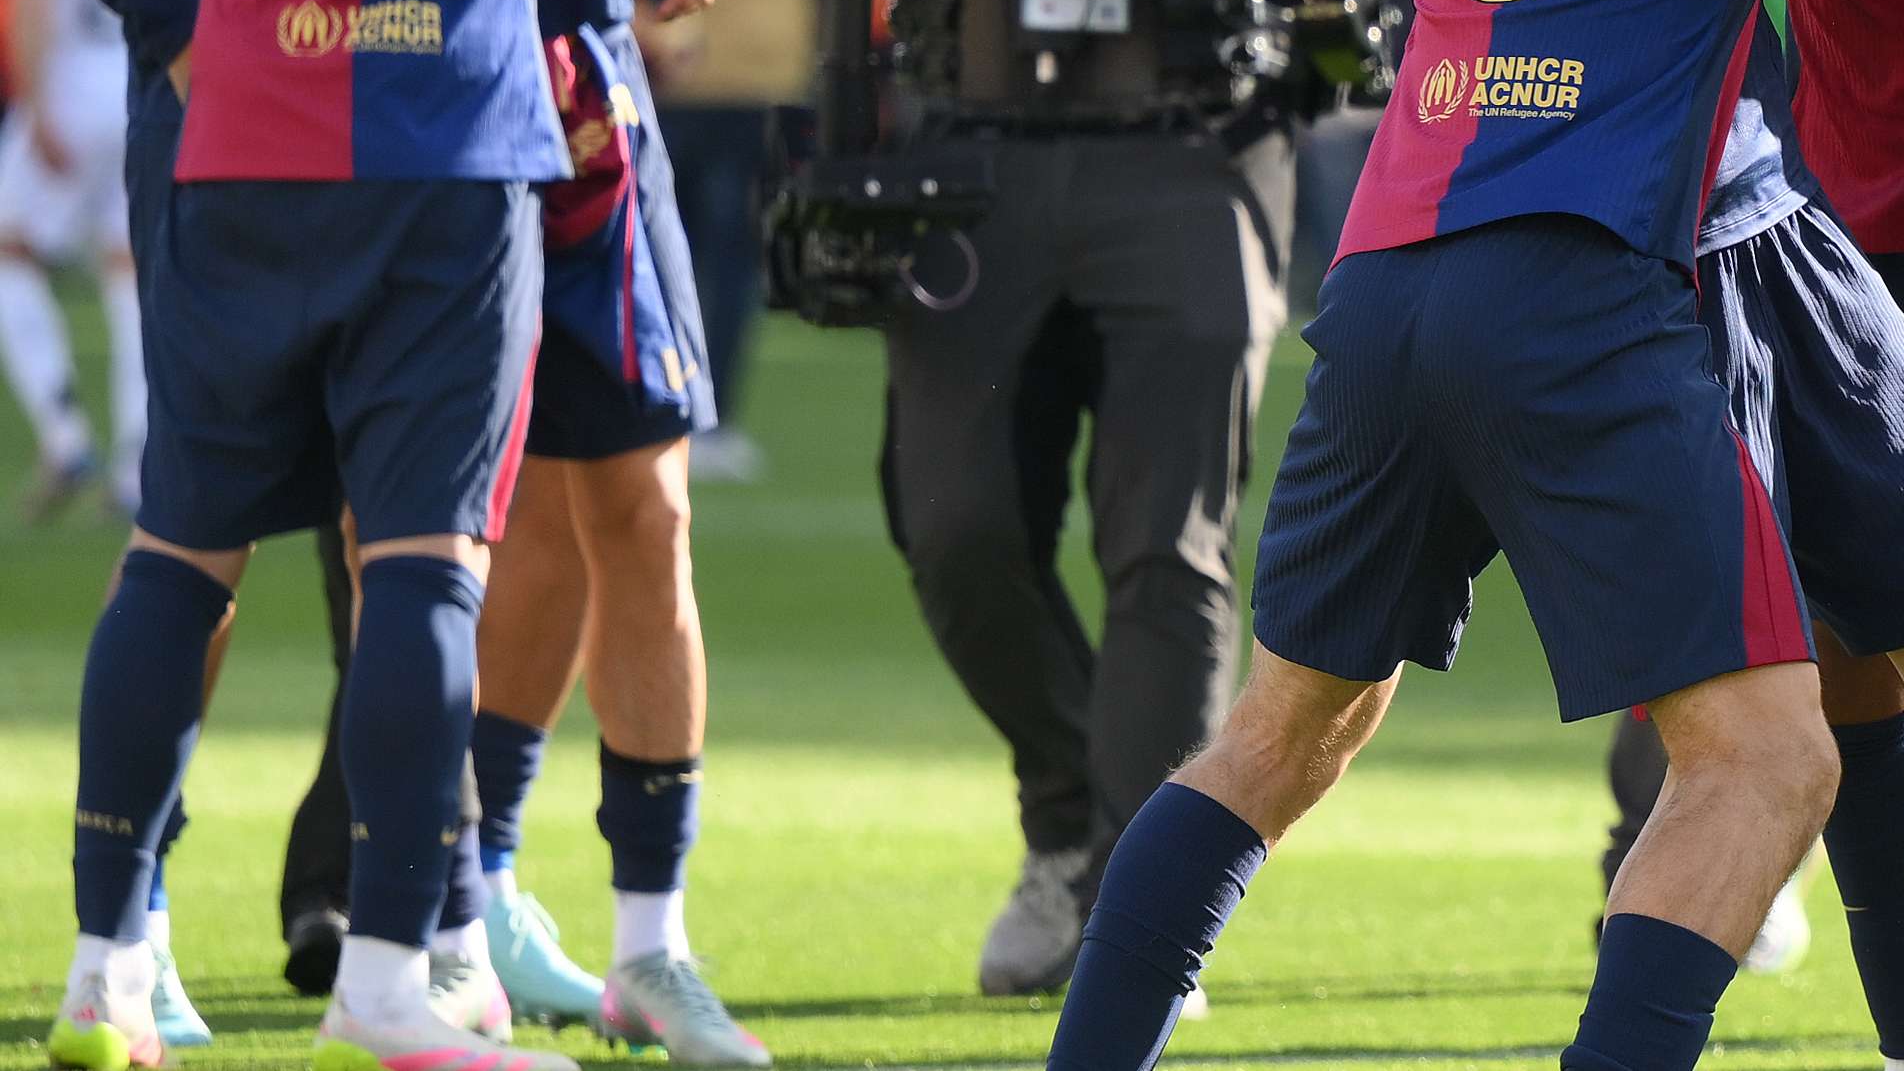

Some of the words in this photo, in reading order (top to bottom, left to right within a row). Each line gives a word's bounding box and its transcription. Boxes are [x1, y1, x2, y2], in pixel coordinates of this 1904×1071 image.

[1474, 56, 1585, 85] UNHCR
[1468, 81, 1581, 109] ACNUR
[1468, 108, 1484, 117] The
[1485, 108, 1499, 117] UN
[1500, 108, 1538, 119] Refugee
[1539, 109, 1576, 121] Agency
